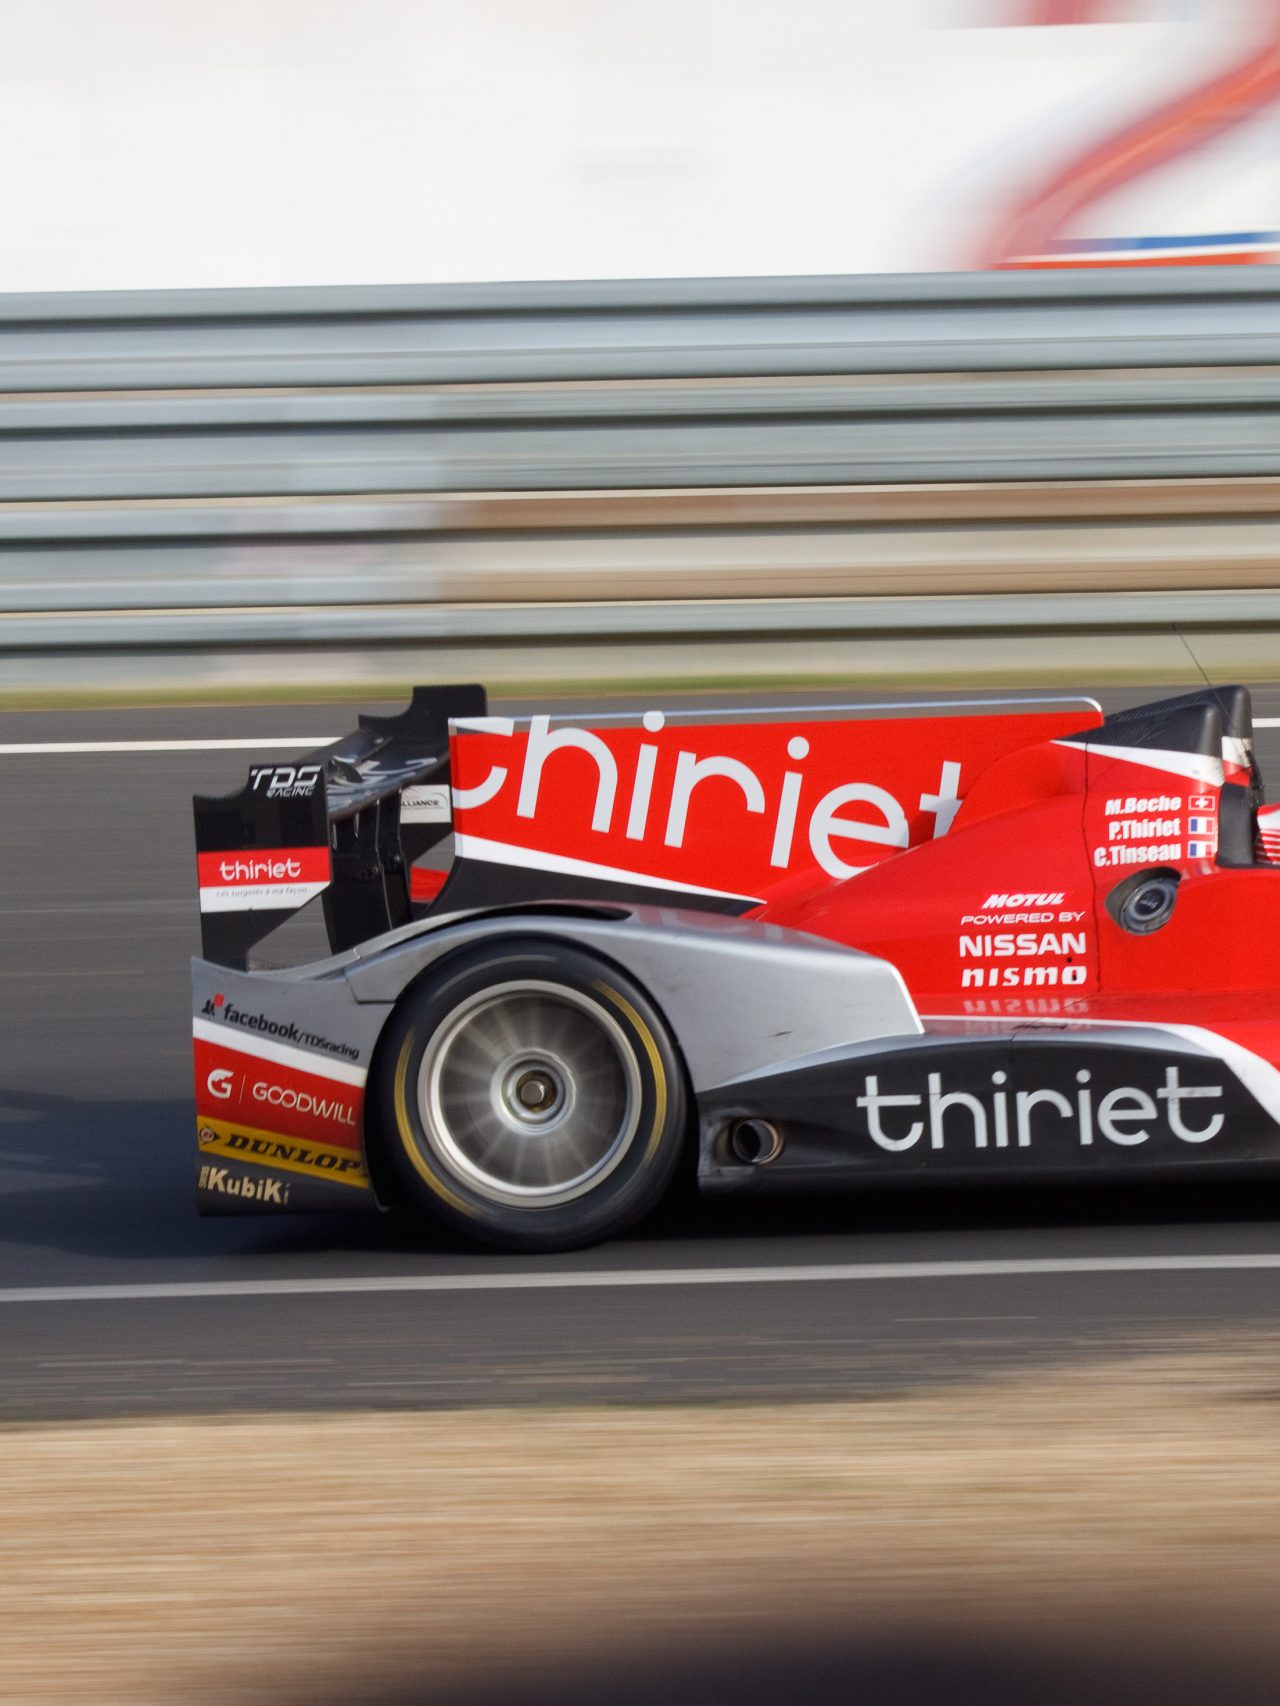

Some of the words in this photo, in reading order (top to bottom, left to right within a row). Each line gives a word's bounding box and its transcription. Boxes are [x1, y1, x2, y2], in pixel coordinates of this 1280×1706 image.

[250, 765, 322, 791] TDS
[1105, 795, 1182, 816] M.Beche
[1109, 817, 1181, 841] P.Thiriet
[1094, 843, 1181, 867] C.Tinseau
[220, 858, 301, 881] thiriet
[982, 892, 1065, 909] MOTUL
[960, 912, 1054, 925] POWERED
[1059, 911, 1086, 923] BY
[959, 932, 1086, 957] NISSAN
[252, 1082, 356, 1126] GOODWILL
[856, 1066, 1225, 1151] thiriet
[224, 1133, 361, 1172] DUNLOP
